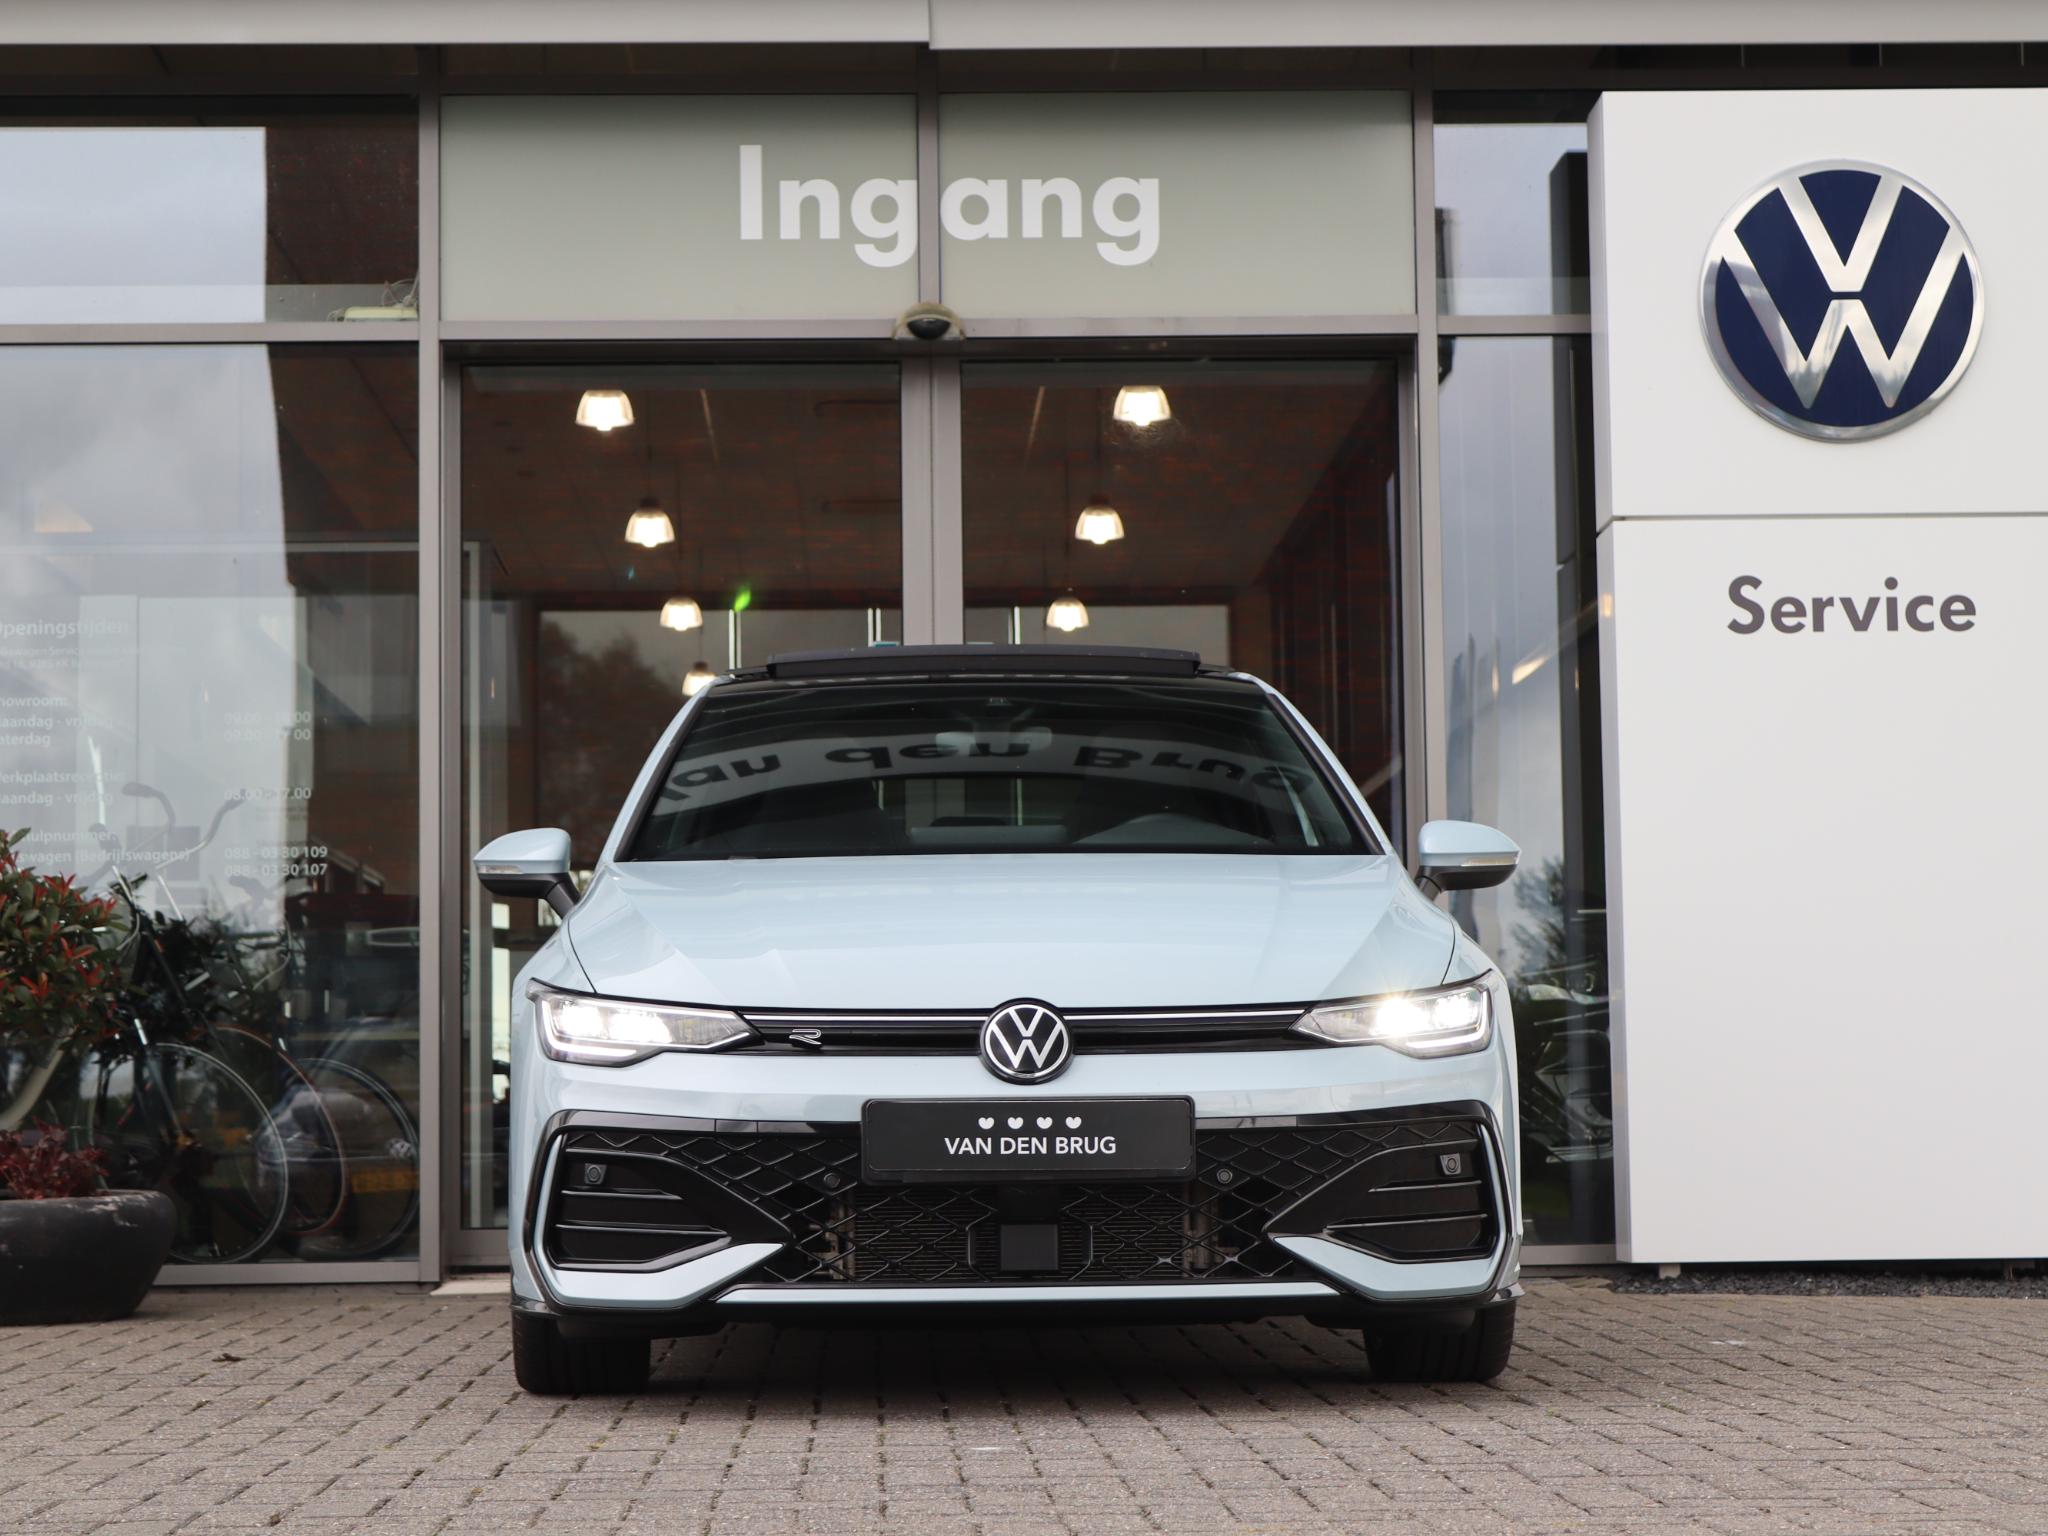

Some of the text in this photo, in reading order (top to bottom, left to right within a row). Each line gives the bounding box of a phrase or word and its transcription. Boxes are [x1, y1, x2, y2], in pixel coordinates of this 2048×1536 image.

[740, 144, 1160, 268] Ingang
[1706, 162, 1979, 428] VW
[1727, 575, 1977, 635] Service
[0, 618, 129, 640] peningstijden
[0, 713, 53, 730] aandag
[0, 791, 54, 807] aandag
[304, 846, 329, 858] 109
[282, 864, 300, 876] 30
[304, 863, 328, 876] 107
[788, 1028, 822, 1046] R
[985, 1004, 1068, 1074] VW
[944, 1136, 1117, 1155] VAN DEN BRUG
